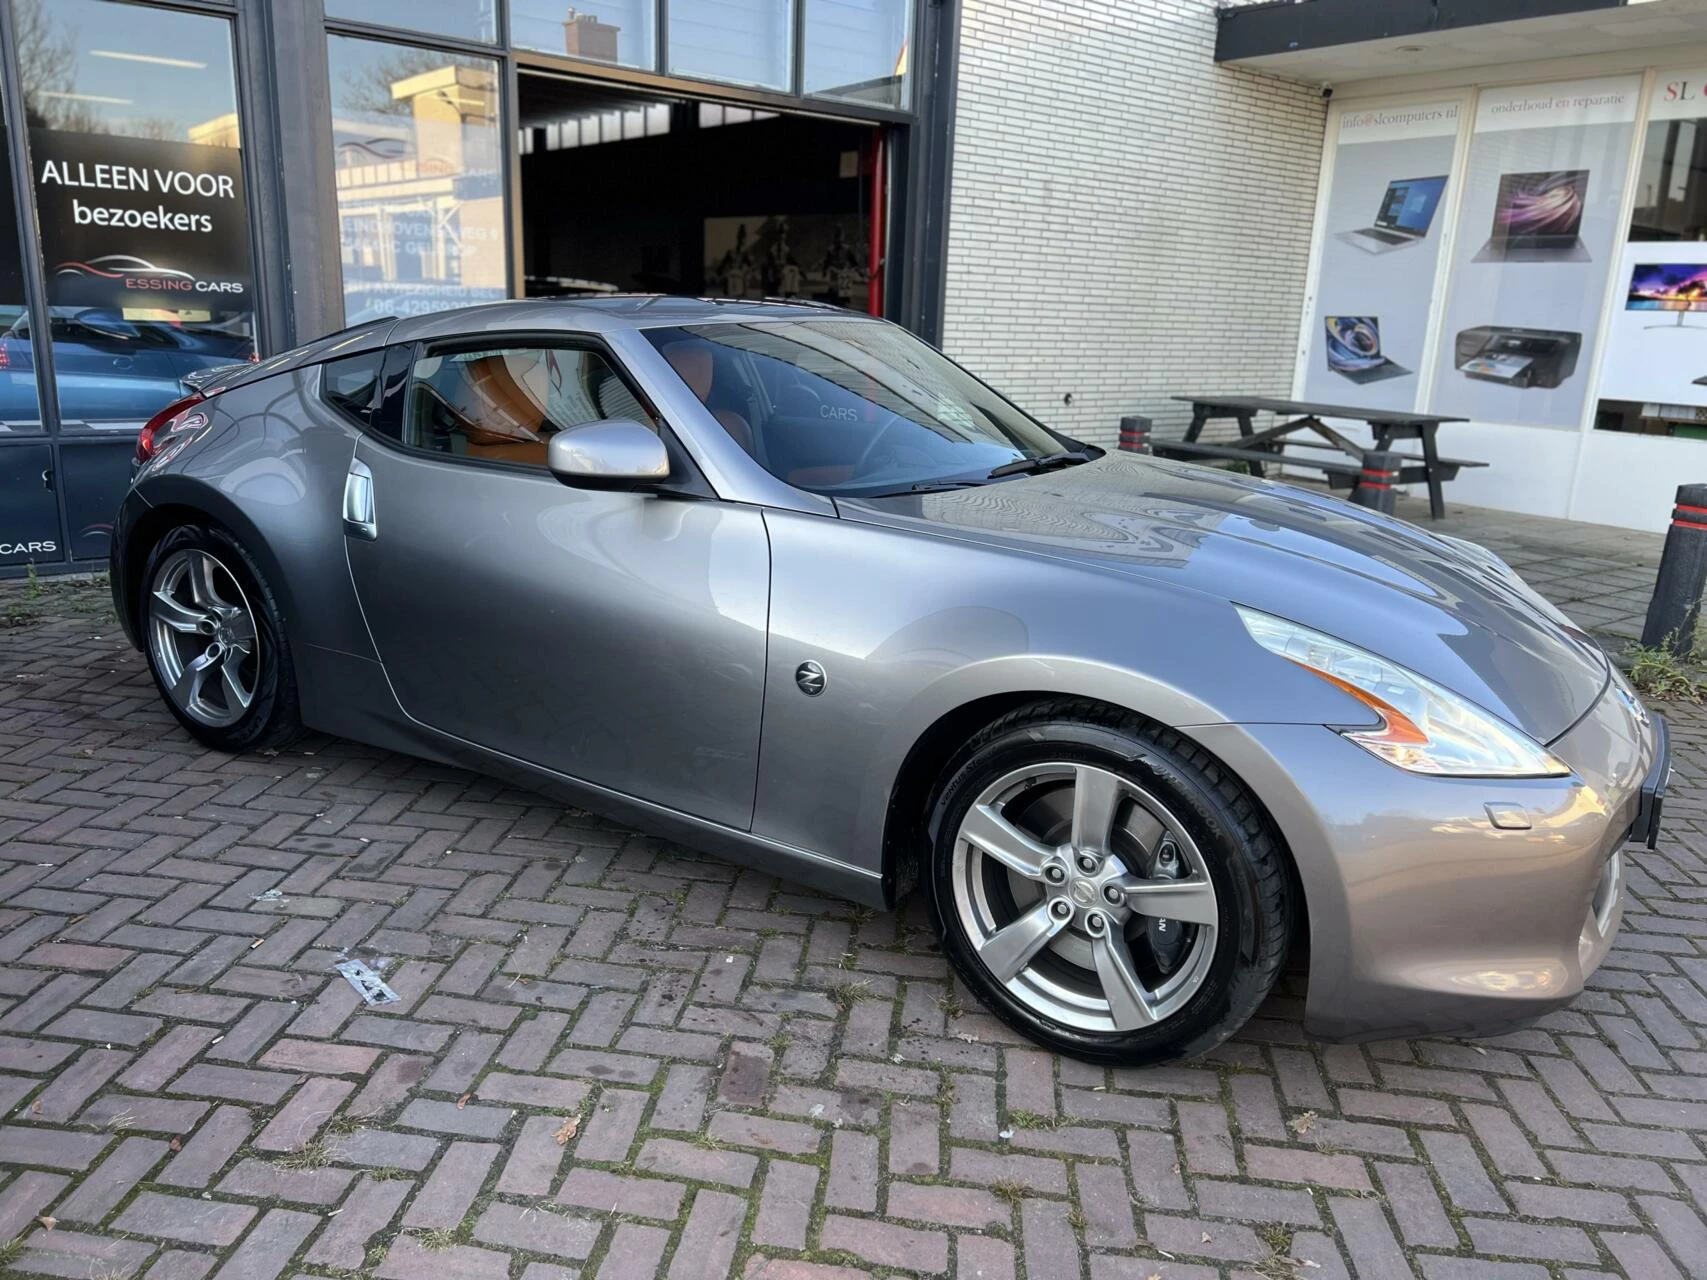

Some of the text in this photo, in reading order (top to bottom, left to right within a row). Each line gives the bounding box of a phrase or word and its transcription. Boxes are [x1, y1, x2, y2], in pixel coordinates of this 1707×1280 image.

[1490, 91, 1625, 114] onderhoud en reparatie
[1664, 81, 1695, 102] SL
[1342, 104, 1458, 129] info@slcomputersnl
[41, 160, 235, 198] ALLEEN VOOR
[72, 199, 213, 233] bezoekers
[125, 279, 244, 294] ESSING CARS
[820, 404, 858, 421] CARS
[0, 540, 57, 554] CARS
